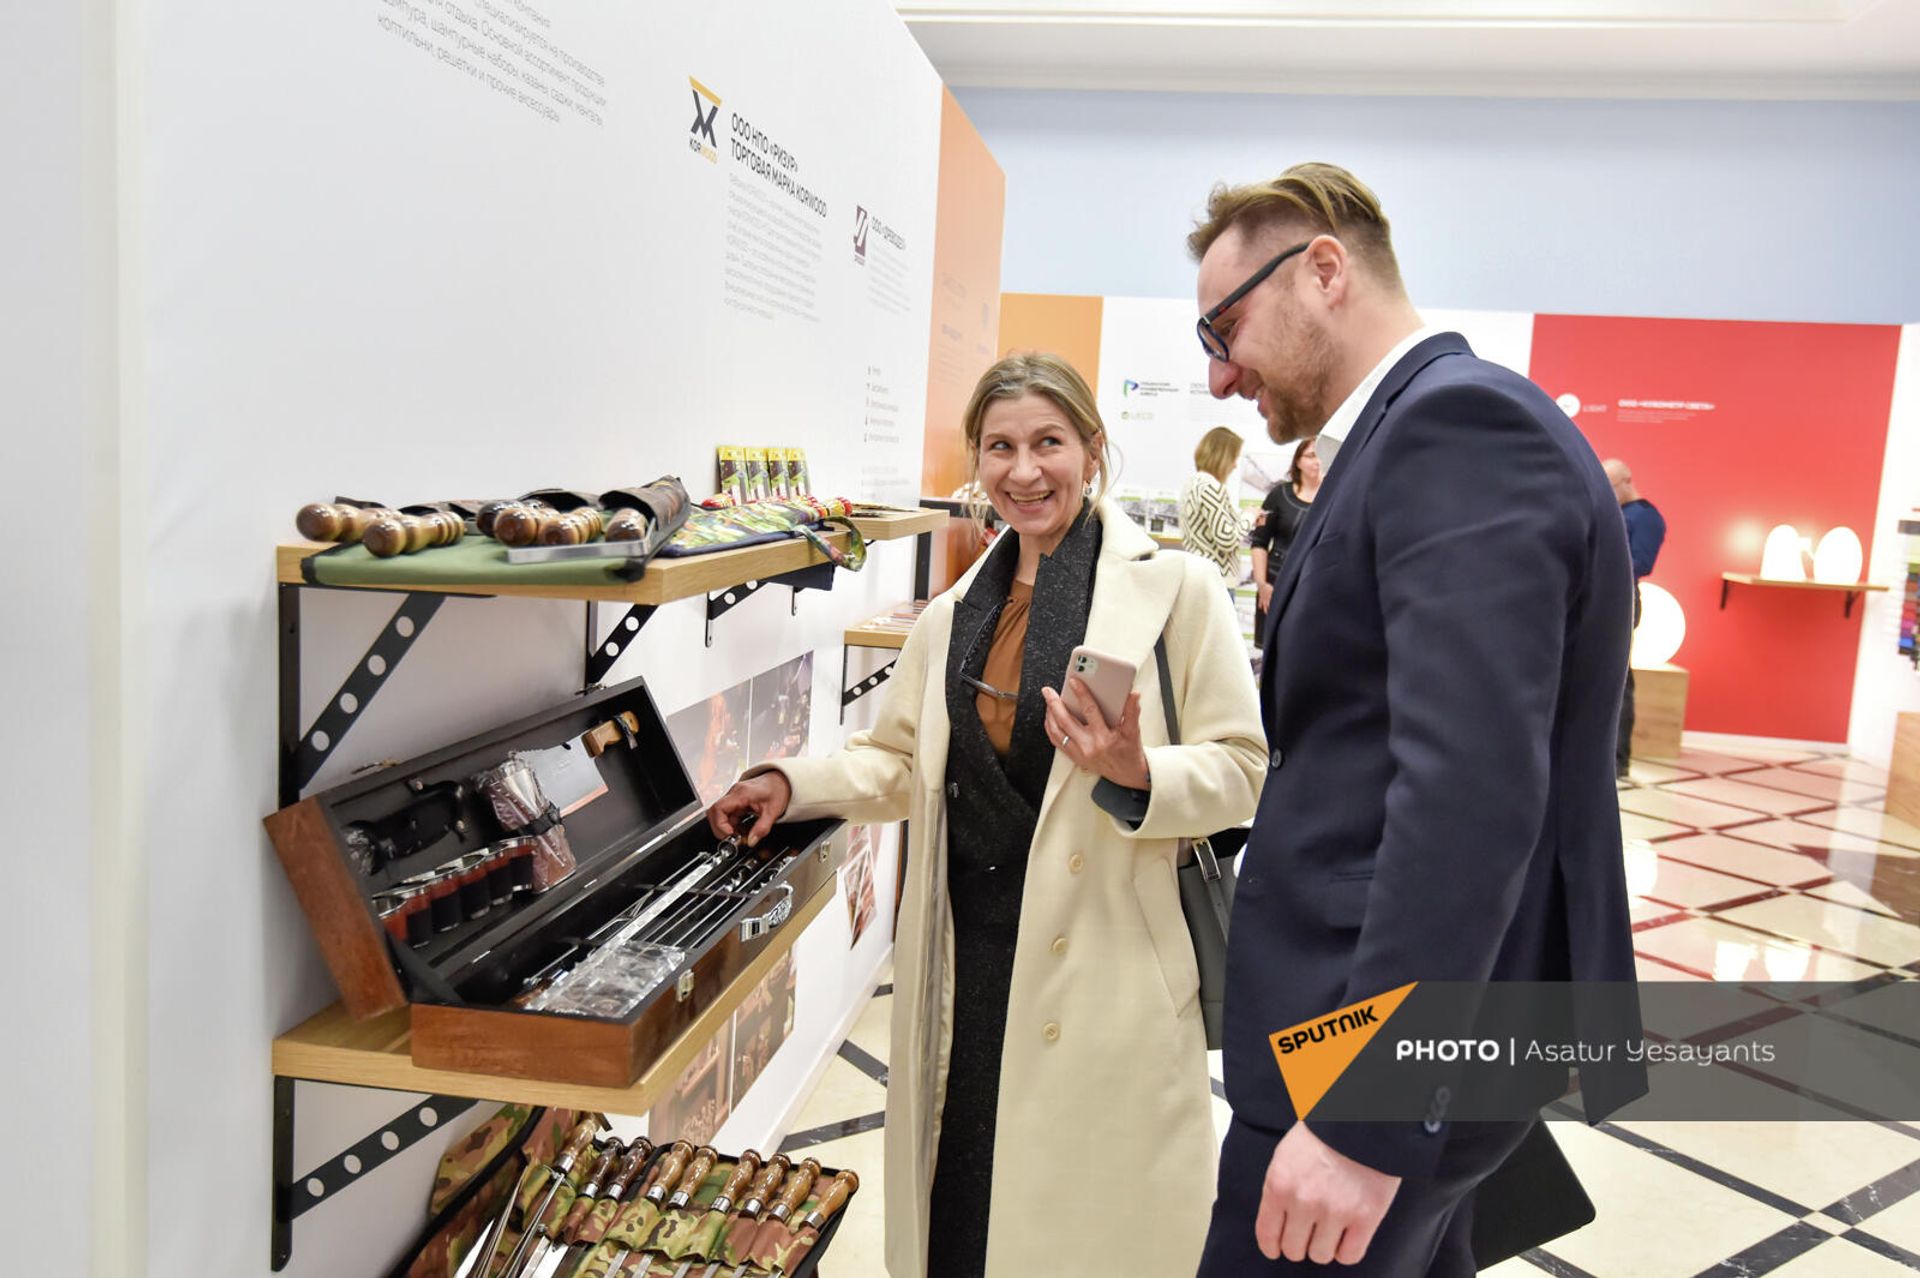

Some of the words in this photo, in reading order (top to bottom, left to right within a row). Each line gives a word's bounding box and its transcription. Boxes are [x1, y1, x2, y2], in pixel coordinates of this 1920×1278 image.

[731, 112, 751, 141] ООО
[752, 125, 769, 155] НПО
[730, 136, 772, 182] ТОРГОВАЯ
[771, 165, 797, 199] МАРКА
